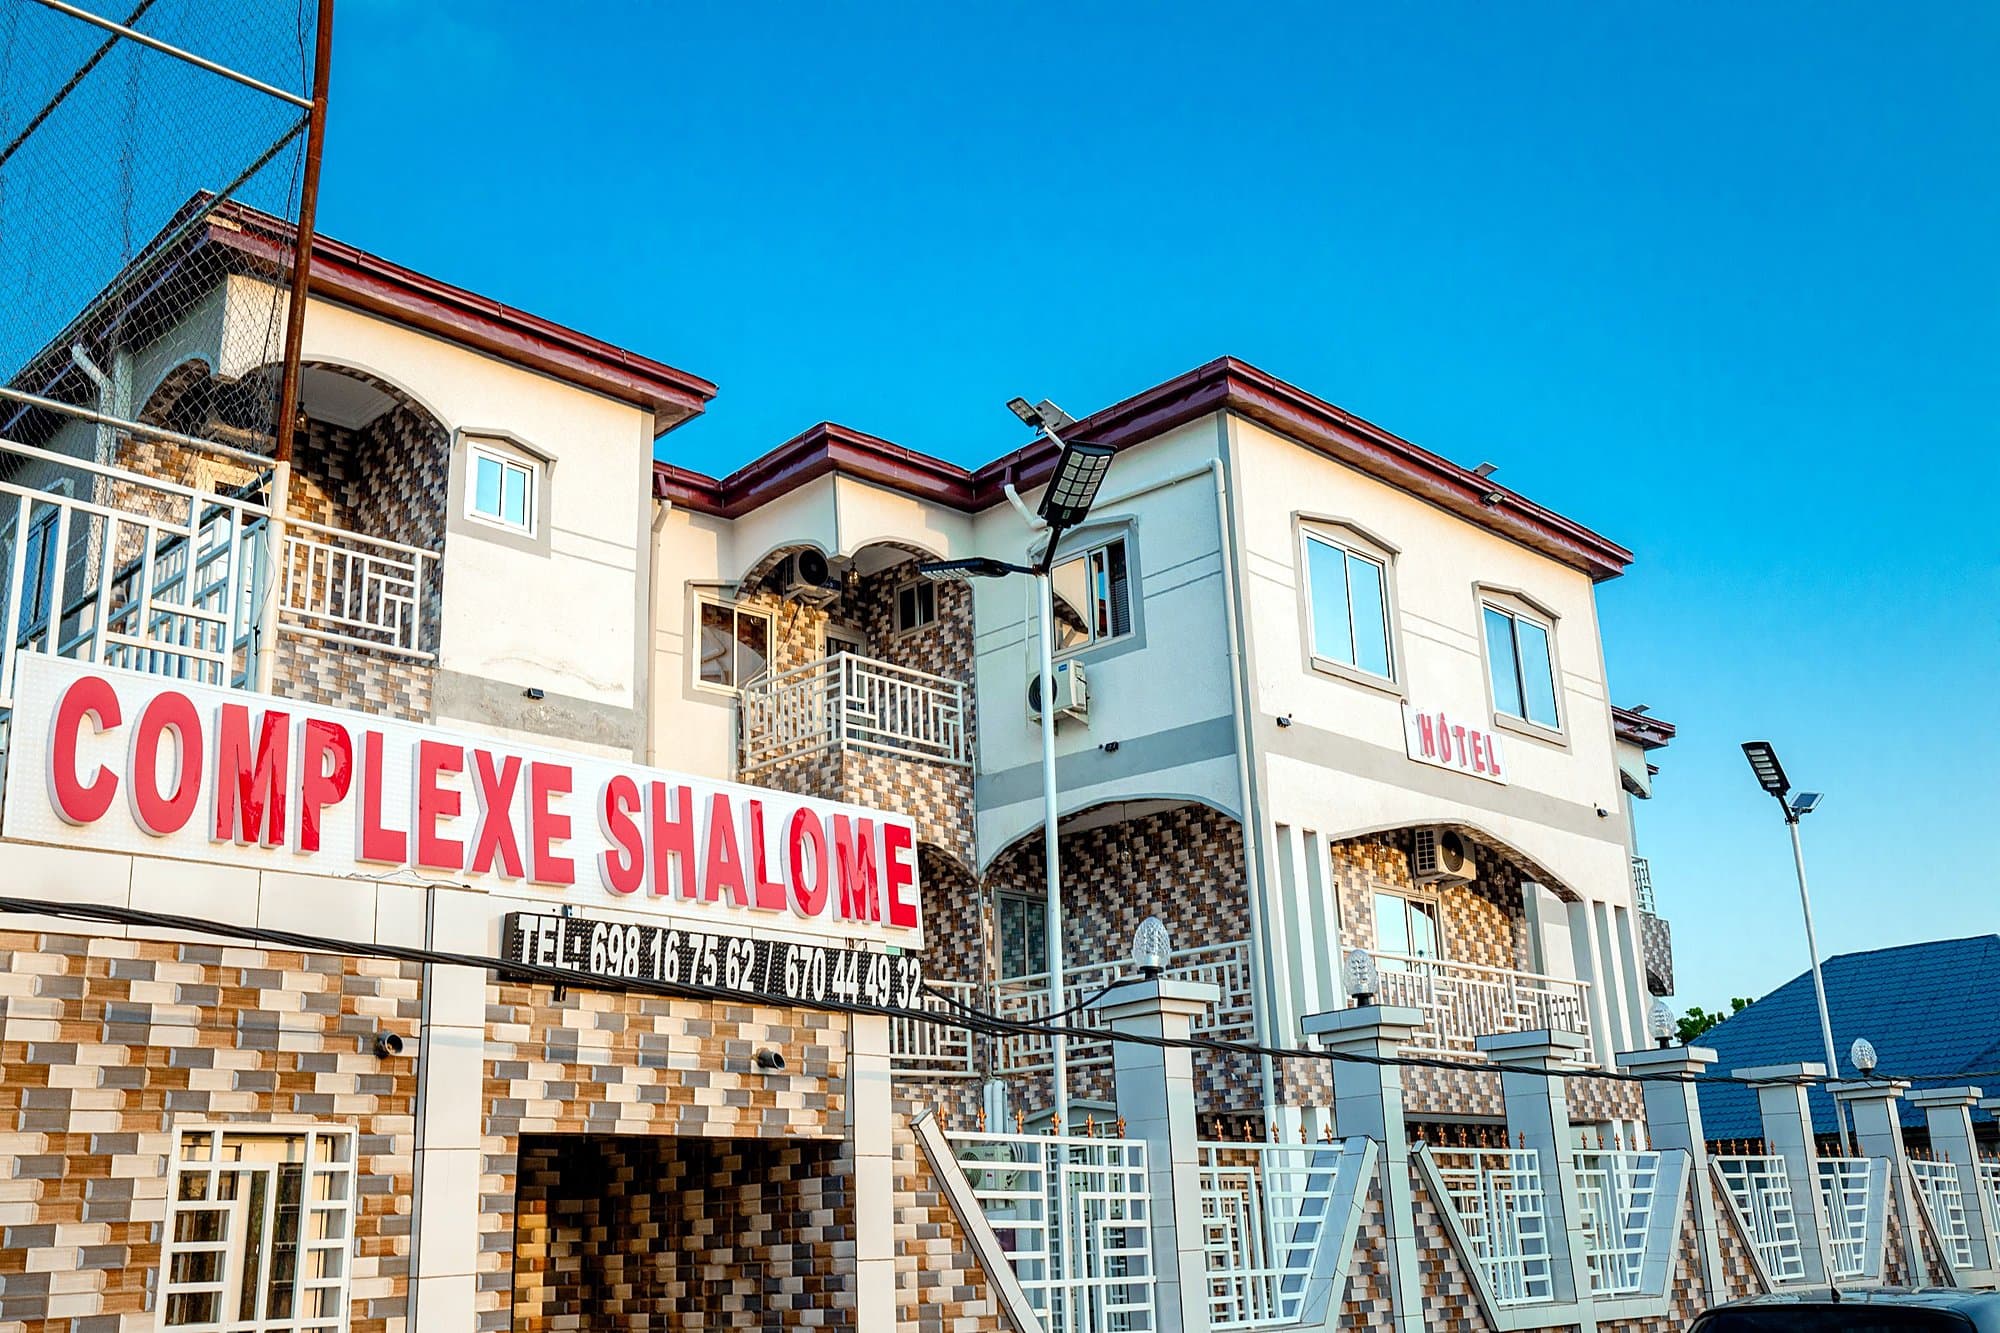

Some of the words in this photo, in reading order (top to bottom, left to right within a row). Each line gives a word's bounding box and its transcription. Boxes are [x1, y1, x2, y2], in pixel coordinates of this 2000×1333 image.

[1416, 711, 1501, 776] HÔTEL
[47, 675, 575, 885] COMPLEXE
[598, 775, 918, 930] SHALOME
[518, 914, 581, 971] TEL:
[590, 922, 640, 978] 698
[650, 928, 680, 982] 16
[688, 933, 719, 986] 75
[726, 938, 755, 992] 62
[763, 941, 774, 994] /
[785, 944, 826, 1001] 670
[833, 950, 859, 1004] 44
[865, 954, 890, 1008] 49
[896, 957, 921, 1010] 32
